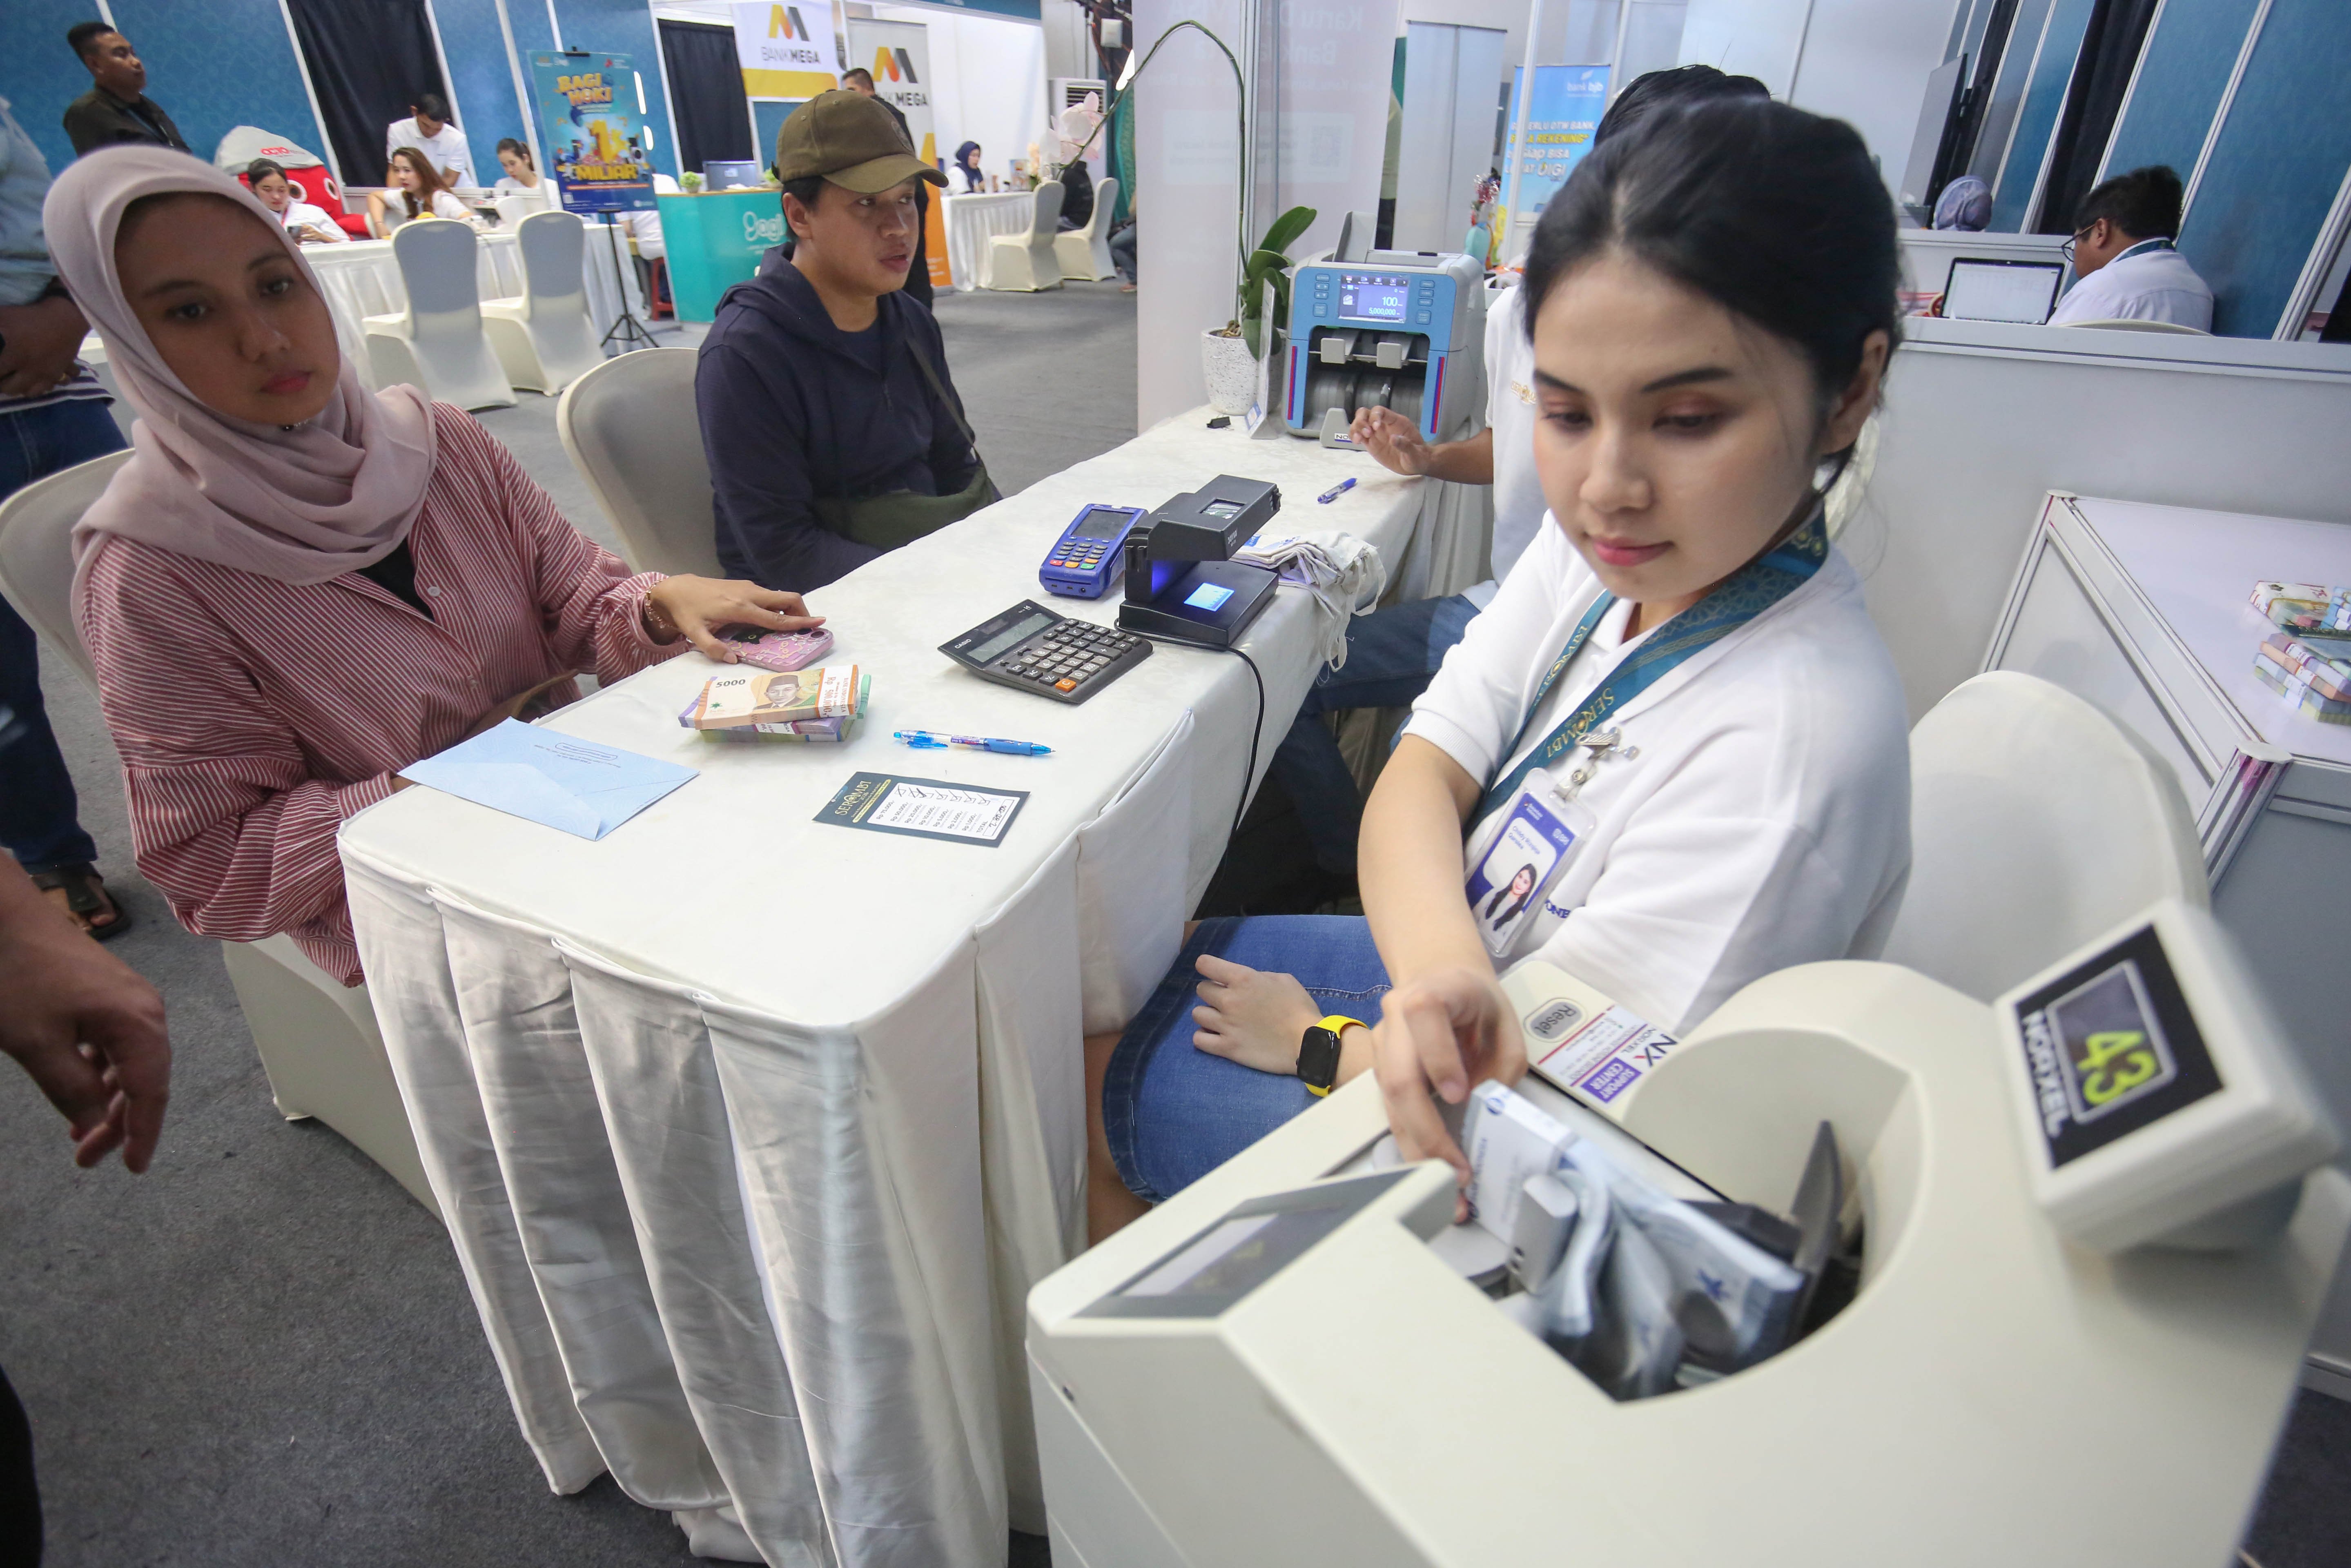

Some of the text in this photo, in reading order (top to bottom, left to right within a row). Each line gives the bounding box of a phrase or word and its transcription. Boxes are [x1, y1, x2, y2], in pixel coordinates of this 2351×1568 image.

[557, 73, 602, 92] BAGI
[567, 87, 612, 106] HOKI
[1382, 297, 1398, 306] 100
[954, 639, 972, 649] CASIO
[715, 679, 746, 688] 5000
[825, 676, 836, 685] Rp
[976, 820, 988, 833] TOTAL
[1534, 1004, 1577, 1035] Reset
[1620, 1027, 1657, 1054] NORXEL
[1633, 1033, 1678, 1068] NX
[1589, 1063, 1624, 1090] CENTER
[2077, 1030, 2157, 1107] 43
[1599, 1069, 1635, 1099] SUPPORT
